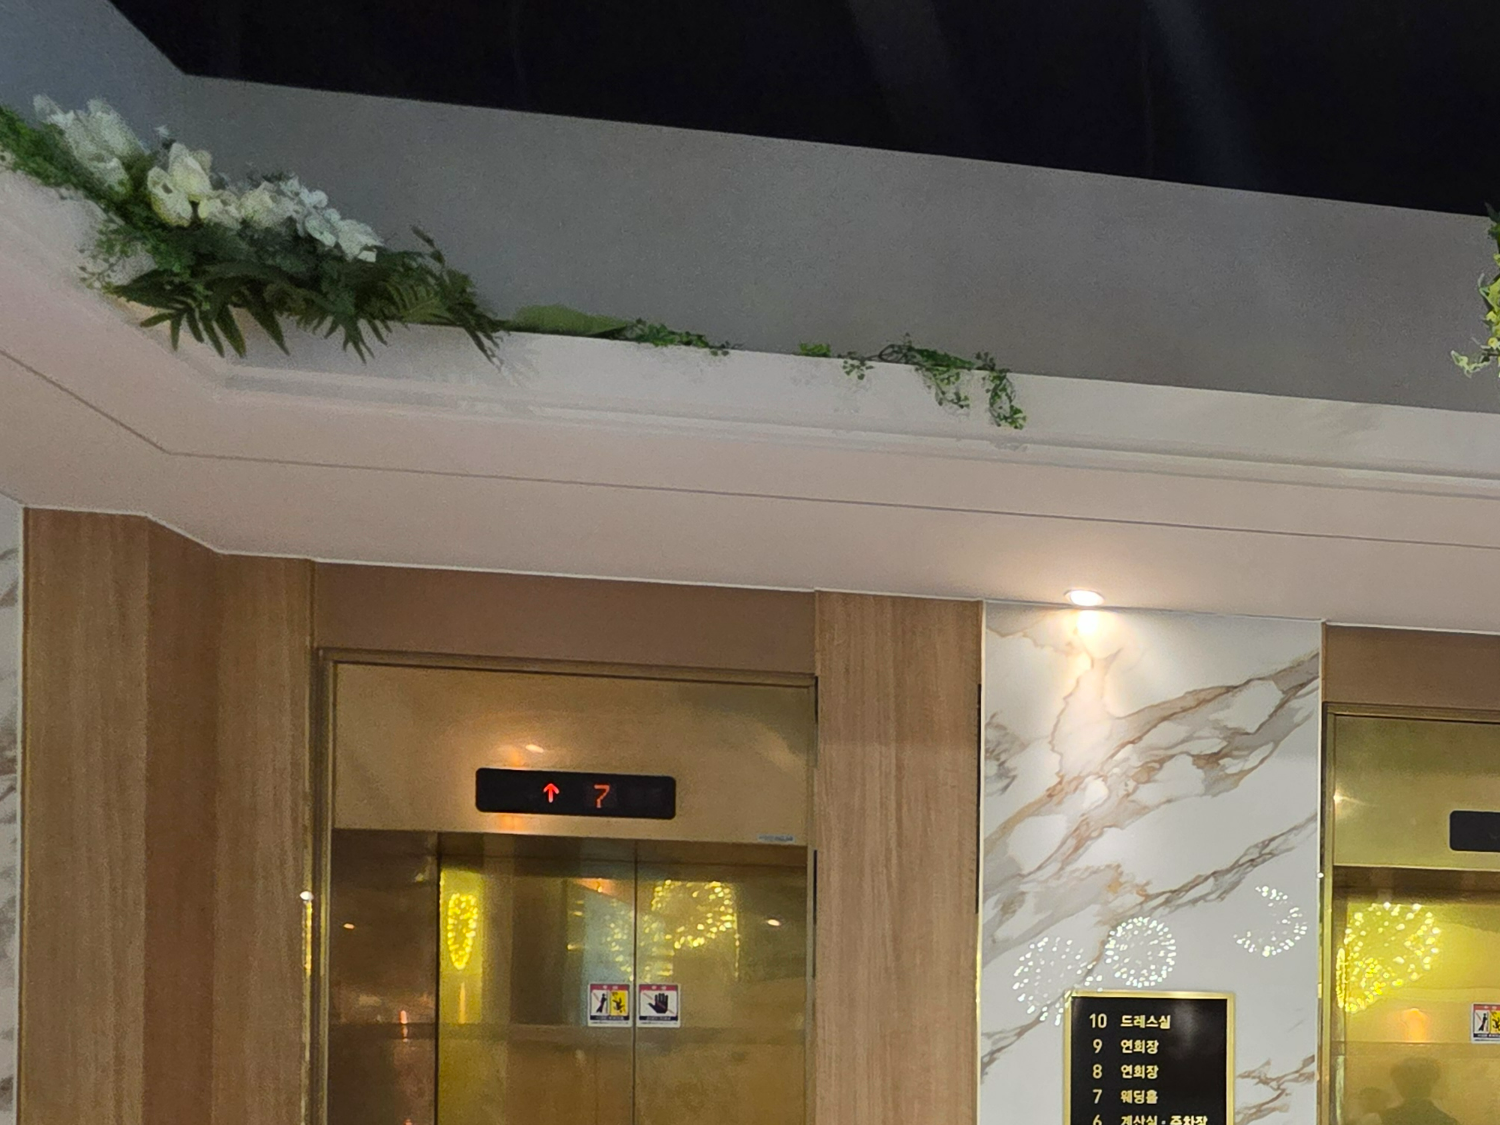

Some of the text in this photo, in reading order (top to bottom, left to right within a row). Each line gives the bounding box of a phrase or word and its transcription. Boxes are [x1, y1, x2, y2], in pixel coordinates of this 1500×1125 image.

[593, 784, 611, 808] 7
[1089, 1013, 1171, 1030] 10 드레스실
[1092, 1038, 1160, 1055] 9 연회장
[1092, 1063, 1159, 1080] 8 연회장
[1092, 1088, 1159, 1105] 7 웨딩홀
